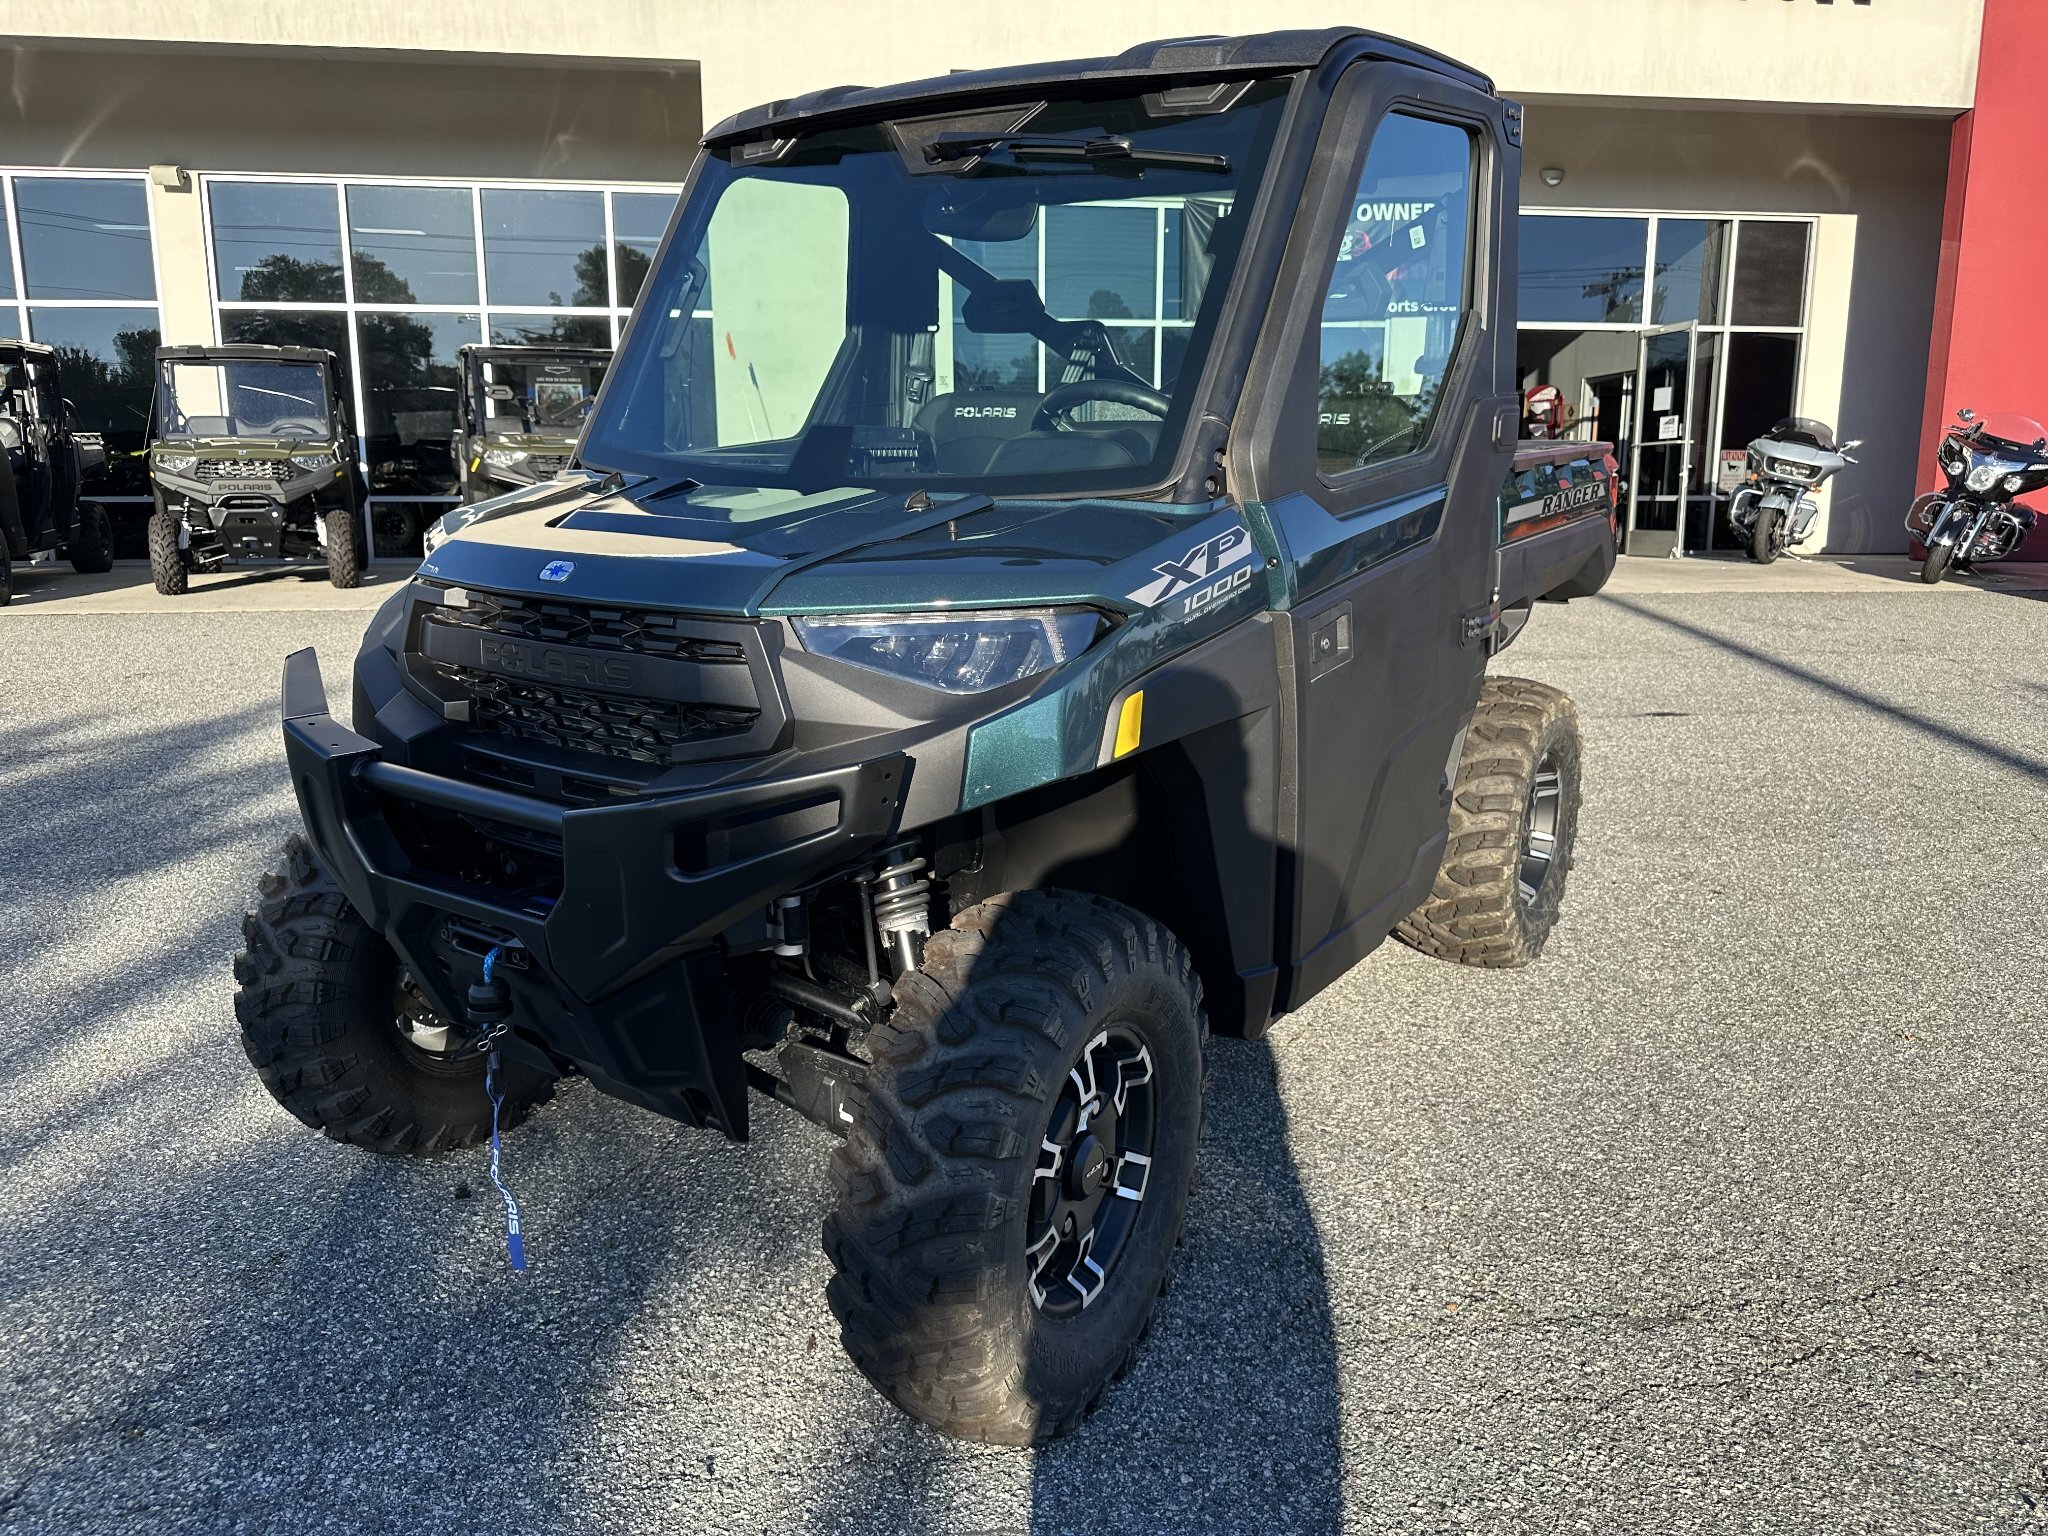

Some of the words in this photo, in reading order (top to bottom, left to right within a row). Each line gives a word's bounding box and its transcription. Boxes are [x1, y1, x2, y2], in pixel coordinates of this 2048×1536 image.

[954, 406, 1017, 418] POLARIS
[218, 483, 273, 491] POLARIS
[1540, 481, 1601, 517] RANGER
[1150, 525, 1250, 604] XP
[1183, 564, 1251, 615] 1000
[480, 638, 633, 689] POLARIS
